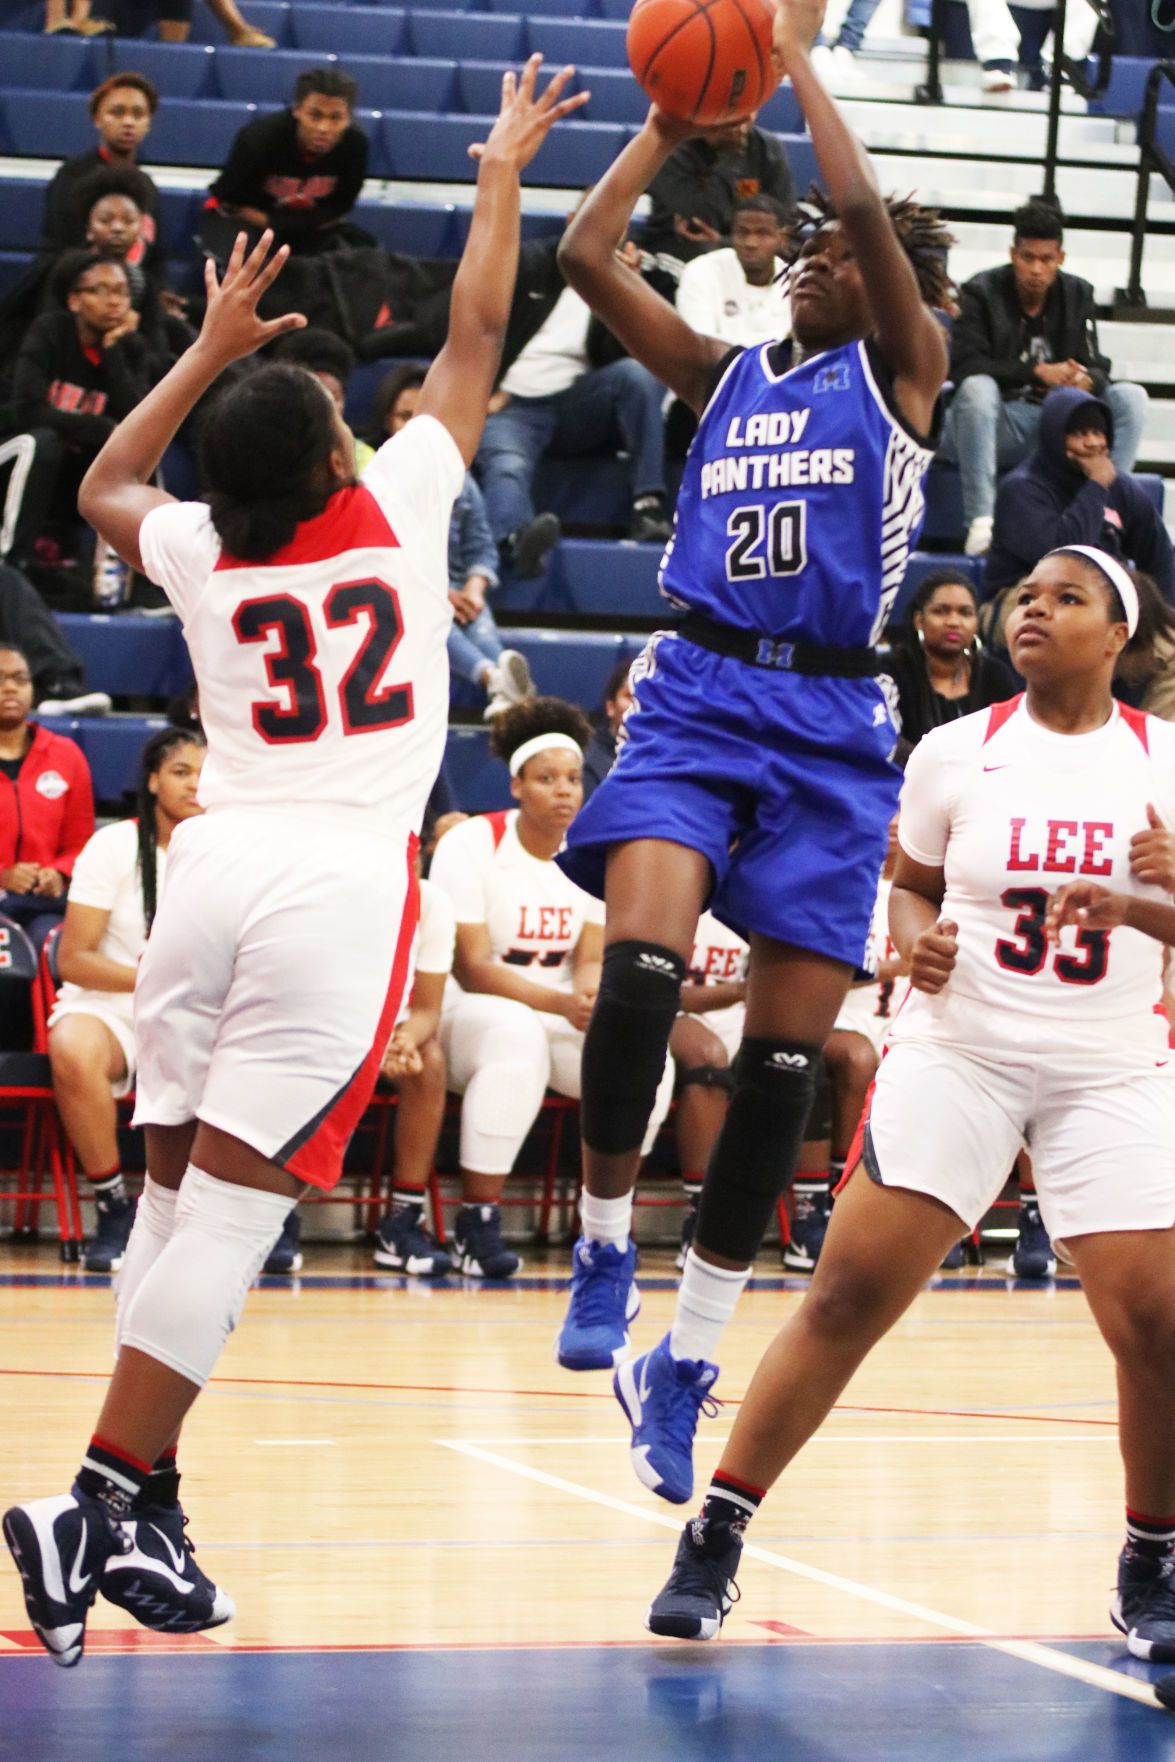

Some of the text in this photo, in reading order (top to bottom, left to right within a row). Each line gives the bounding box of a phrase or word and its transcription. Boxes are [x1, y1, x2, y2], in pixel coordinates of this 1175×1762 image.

[725, 407, 810, 448] LADY
[701, 449, 855, 500] PANTHERS
[725, 499, 808, 582] 20
[231, 576, 415, 745] 32
[1006, 817, 1114, 877] LEE
[517, 906, 573, 940] LEE
[994, 886, 1112, 986] 33
[689, 944, 741, 977] EE
